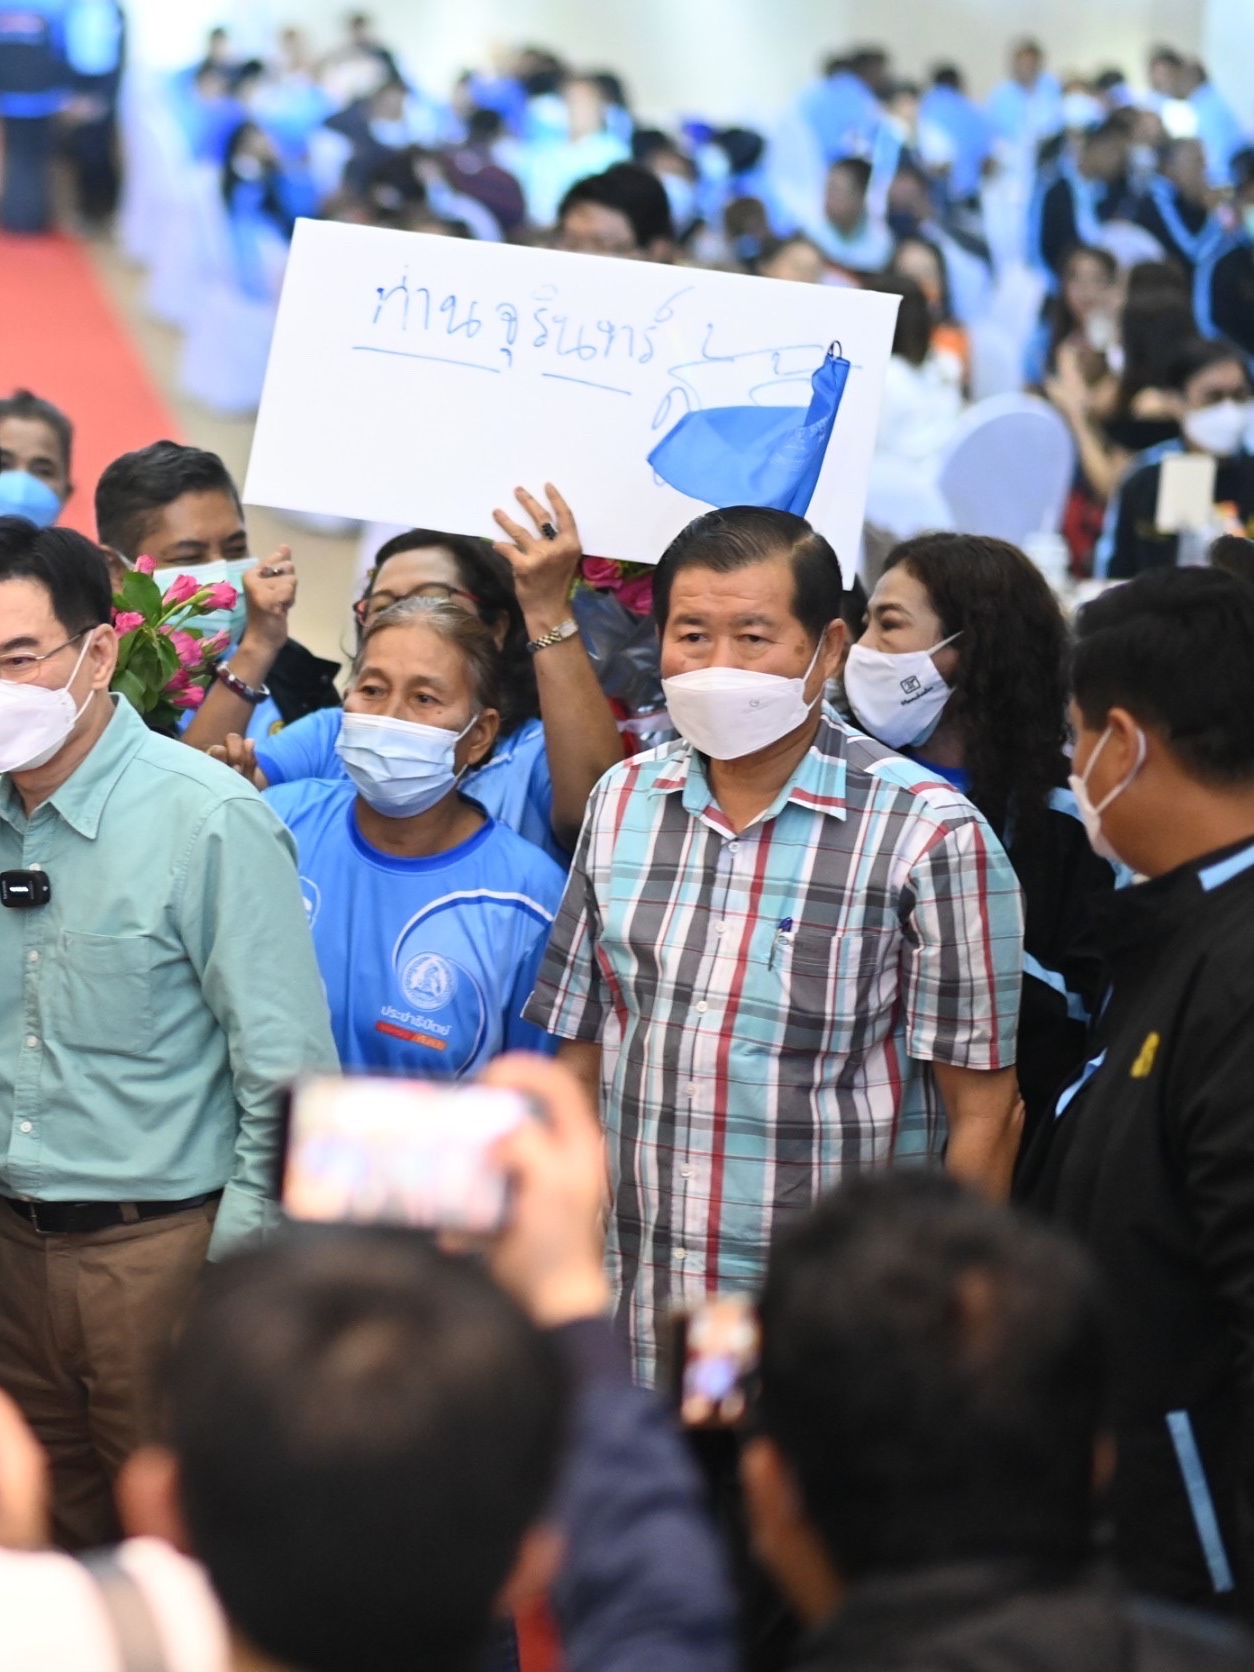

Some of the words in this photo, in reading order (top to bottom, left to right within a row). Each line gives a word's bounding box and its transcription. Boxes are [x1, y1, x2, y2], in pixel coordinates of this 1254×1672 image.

[381, 1006, 452, 1036] ประชาธิปัตย์
